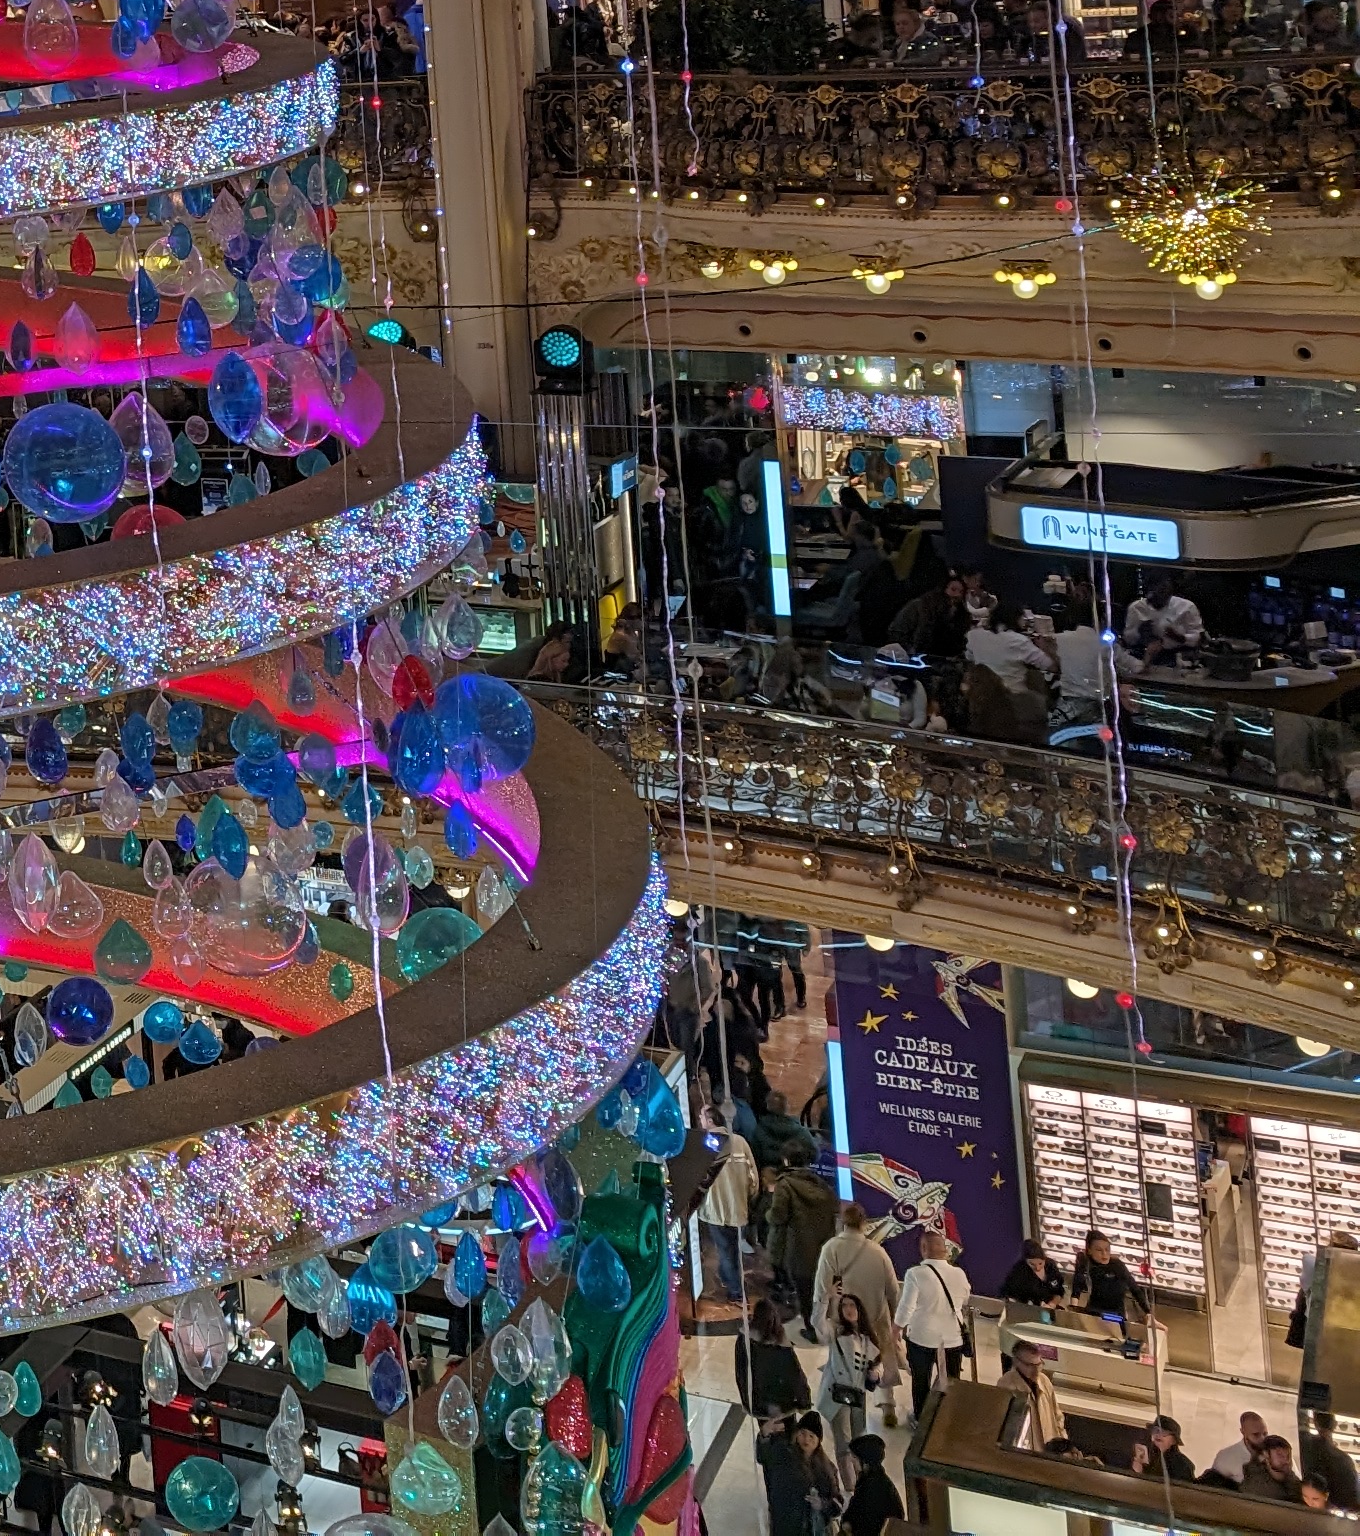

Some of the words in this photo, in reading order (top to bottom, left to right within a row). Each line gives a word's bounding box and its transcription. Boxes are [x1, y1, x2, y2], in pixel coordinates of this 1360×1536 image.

[1113, 528, 1159, 544] GATE
[895, 1035, 953, 1057] IDÉES
[874, 1049, 978, 1080] CADEAUX
[875, 1072, 980, 1101] BIEN-ÊTRE
[879, 1101, 936, 1122] WELLNESS
[937, 1111, 983, 1129] GALERIE
[908, 1120, 942, 1137] ÉTAGE
